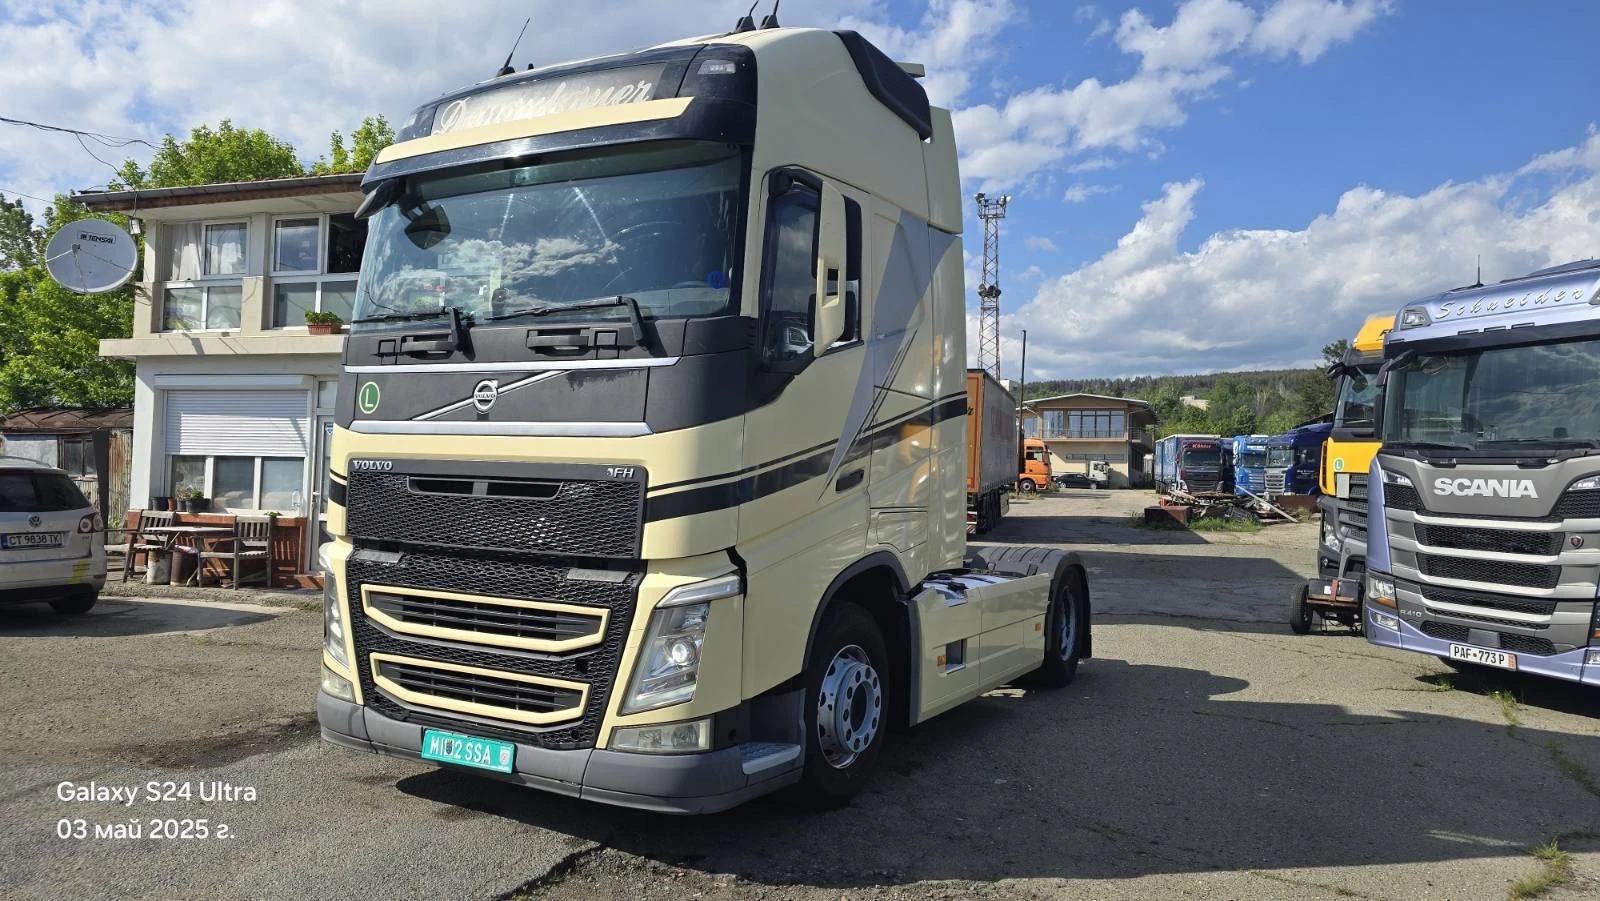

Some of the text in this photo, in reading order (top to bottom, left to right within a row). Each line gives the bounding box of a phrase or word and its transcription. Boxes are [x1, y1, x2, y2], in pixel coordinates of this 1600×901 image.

[1435, 288, 1584, 320] Schneider
[353, 460, 393, 471] VOLVO
[613, 467, 634, 478] FH
[1433, 477, 1539, 499] SCANIA
[9, 535, 22, 546] CT
[1454, 645, 1471, 659] PAF
[464, 741, 491, 765] SSA
